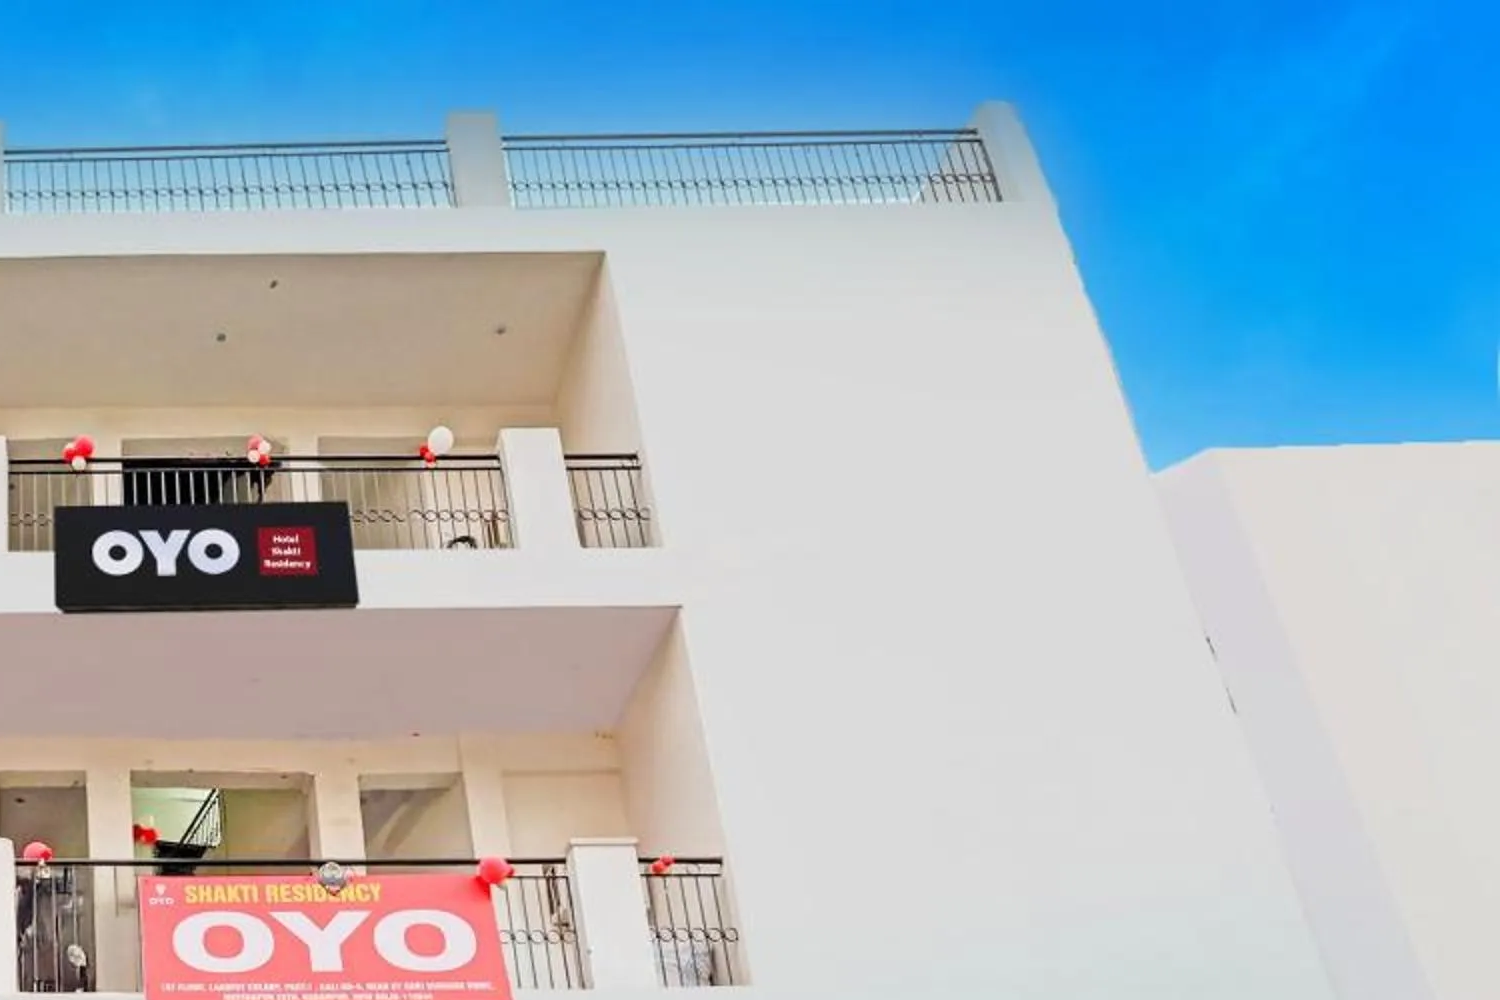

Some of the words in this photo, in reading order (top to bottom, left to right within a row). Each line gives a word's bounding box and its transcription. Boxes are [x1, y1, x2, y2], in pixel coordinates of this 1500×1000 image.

[272, 533, 300, 544] Hotel
[91, 528, 241, 577] OYO
[263, 558, 311, 570] Residency
[184, 883, 259, 904] SHAKTI
[171, 908, 478, 974] OYO
